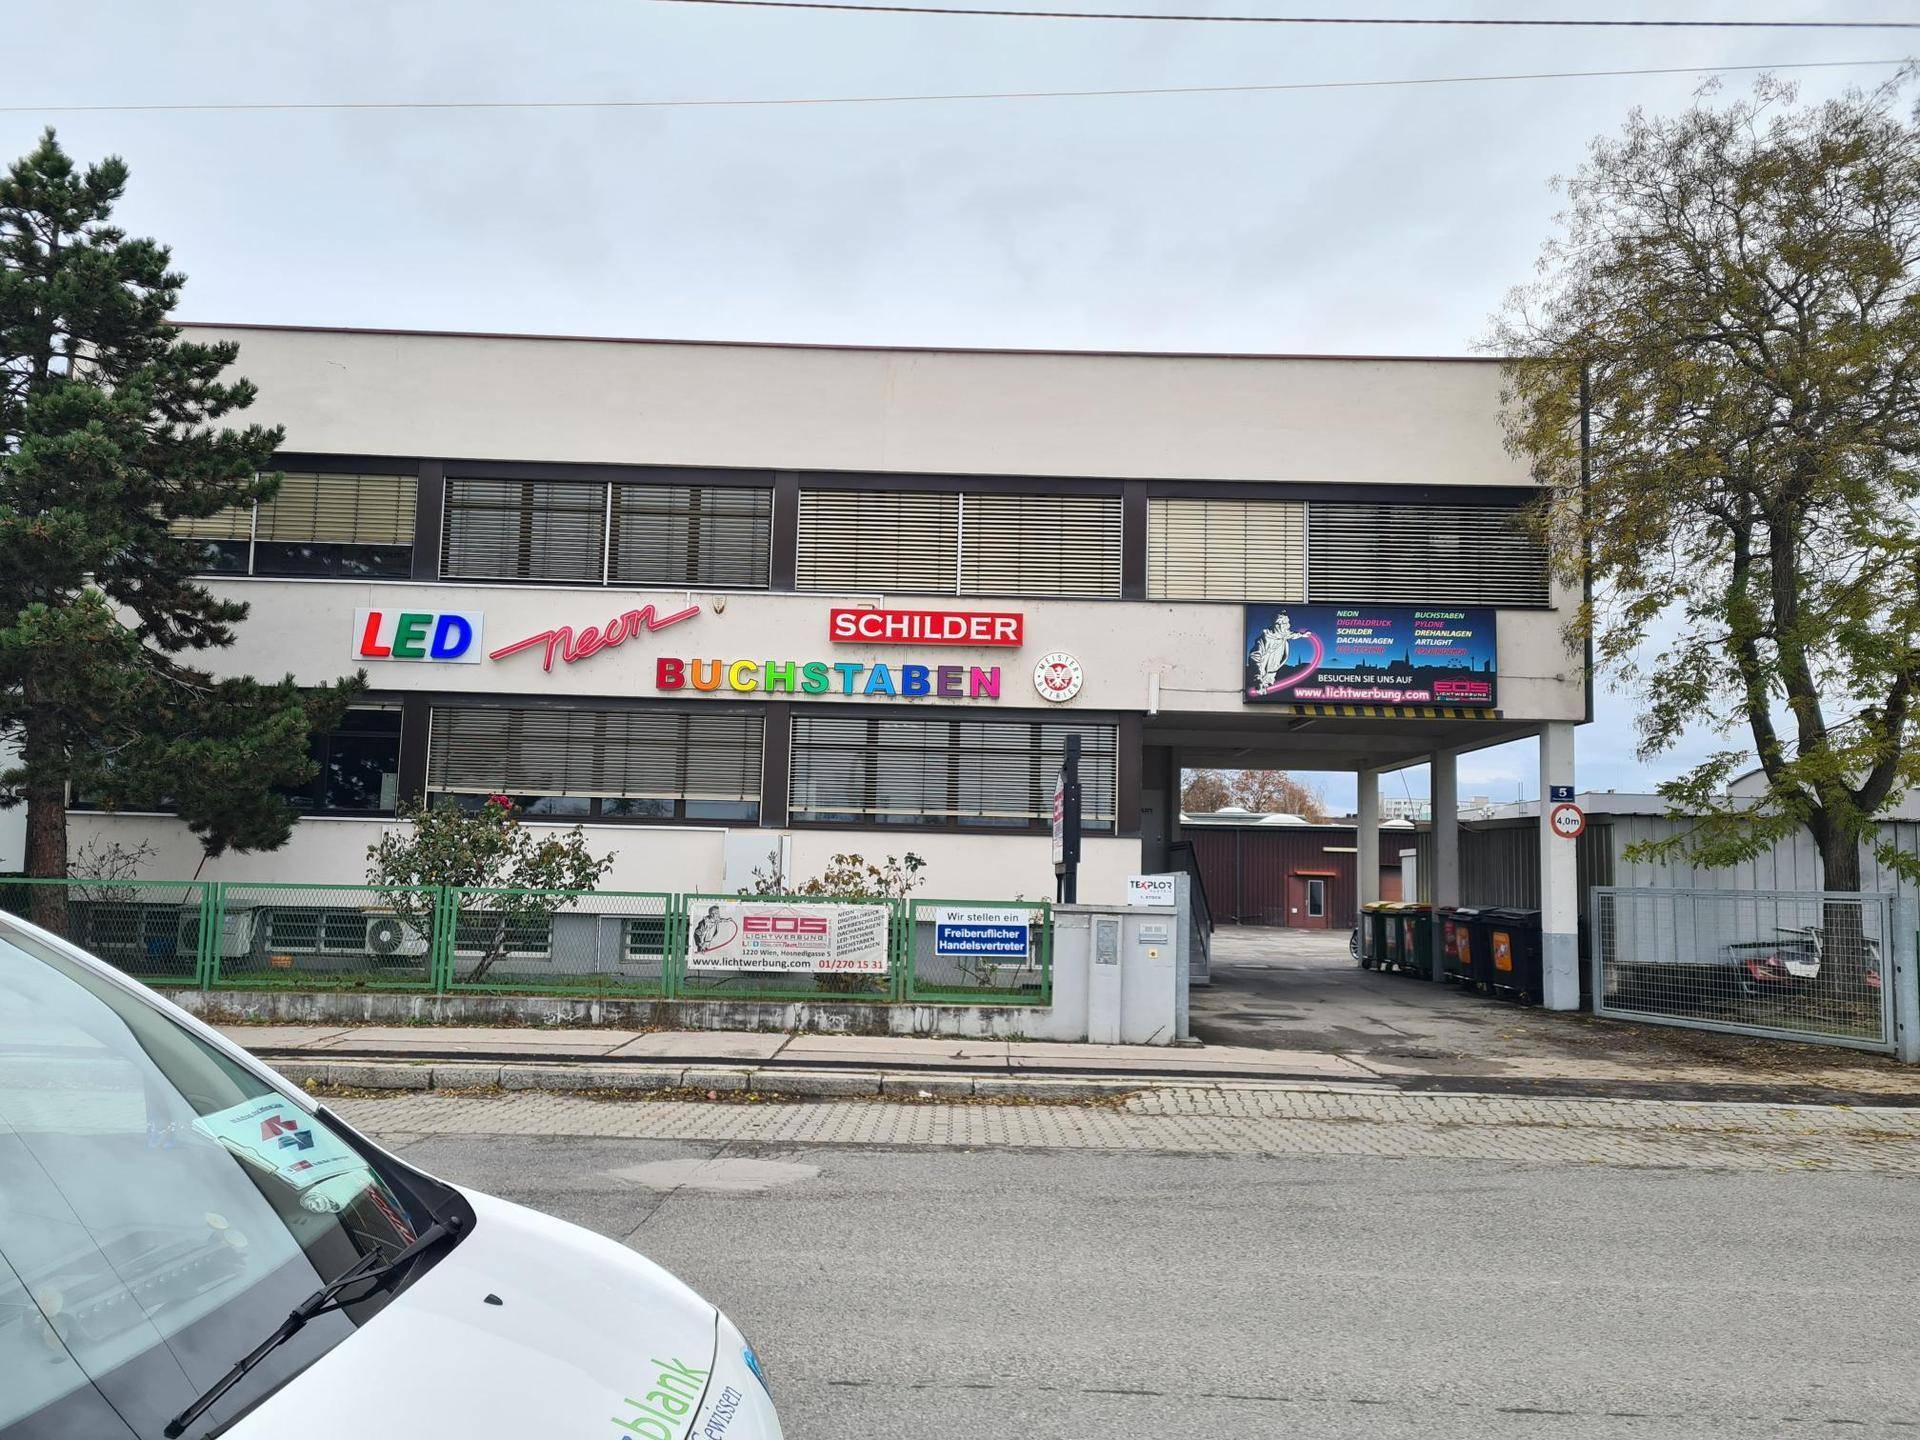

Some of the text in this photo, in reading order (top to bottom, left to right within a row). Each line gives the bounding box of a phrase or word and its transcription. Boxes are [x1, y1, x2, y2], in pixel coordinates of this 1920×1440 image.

[1414, 611, 1465, 619] BUCHSTABEN
[835, 613, 1018, 641] SCHILDER
[360, 611, 473, 659] LED
[1414, 629, 1473, 637] DREHANLAGEN
[1336, 636, 1395, 645] DACHANLAGEN
[656, 658, 1001, 699] BUCHSTABEN
[1318, 674, 1414, 684] BESUCHEN SIE UNS AUF
[1294, 686, 1430, 701] www.lichtwerbung.com
[1558, 787, 1568, 798] 5
[1556, 816, 1580, 826] 4,0m
[1130, 880, 1173, 890] TEXPLOR
[947, 912, 1019, 922] Wir stellen ein
[743, 916, 827, 934] EOS
[745, 933, 824, 941] LICHTWERBUNG
[944, 928, 1020, 939] Freiberuflicher
[939, 940, 1025, 951] Handelsvertreter
[760, 949, 779, 957] Wien,
[692, 957, 811, 969] www.lichtwerbung.com
[818, 959, 883, 969] 01/270 15 31
[611, 1358, 710, 1440] blank
